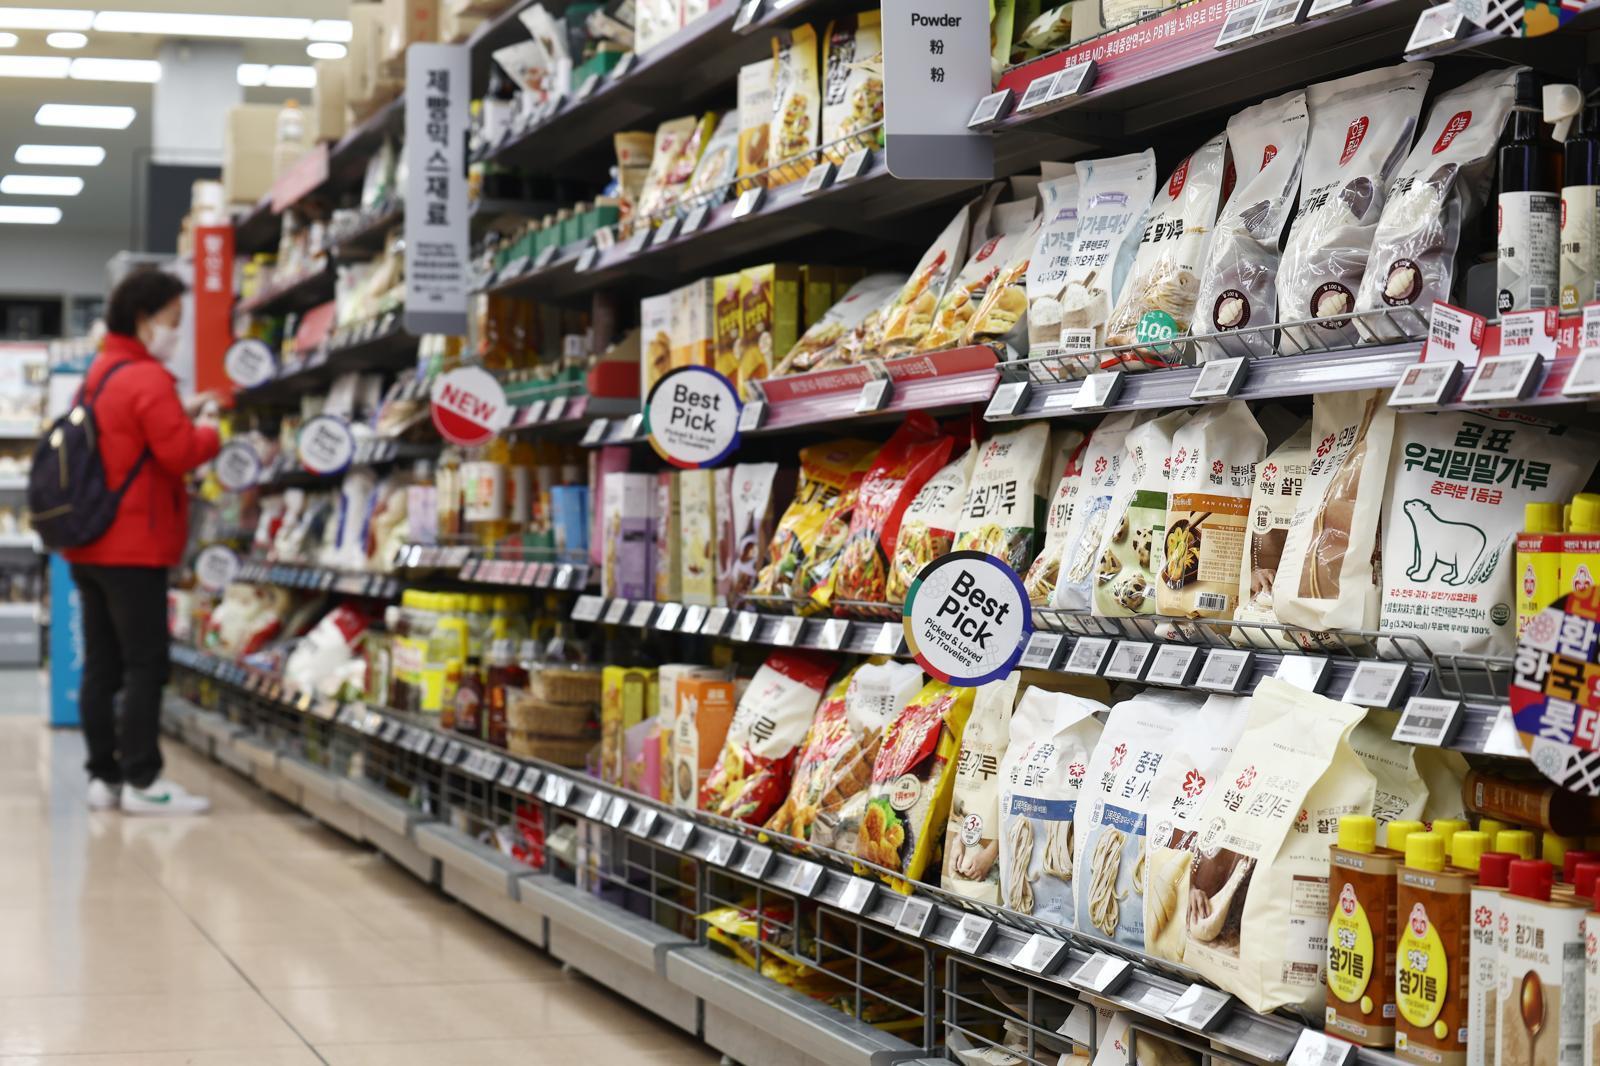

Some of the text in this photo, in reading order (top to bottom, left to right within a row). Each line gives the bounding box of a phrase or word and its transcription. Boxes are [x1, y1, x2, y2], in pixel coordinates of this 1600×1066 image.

[911, 13, 962, 27] Powder
[930, 39, 944, 55] 粉
[930, 67, 945, 83] 粉
[440, 383, 497, 422] NEW
[674, 384, 721, 412] Best
[670, 406, 716, 433] Pick
[1454, 421, 1516, 453] 곰표
[1404, 442, 1552, 492] 우리밀밀가루
[1430, 480, 1503, 505] 중력분 1등급
[951, 569, 1010, 626] Best
[936, 595, 994, 650] Pick
[924, 617, 983, 663] Picked & Loved
[924, 629, 972, 667] by Travelers
[1515, 924, 1545, 950] 참기름
[1329, 946, 1364, 980] 참기름
[1399, 968, 1437, 1002] 참기름
